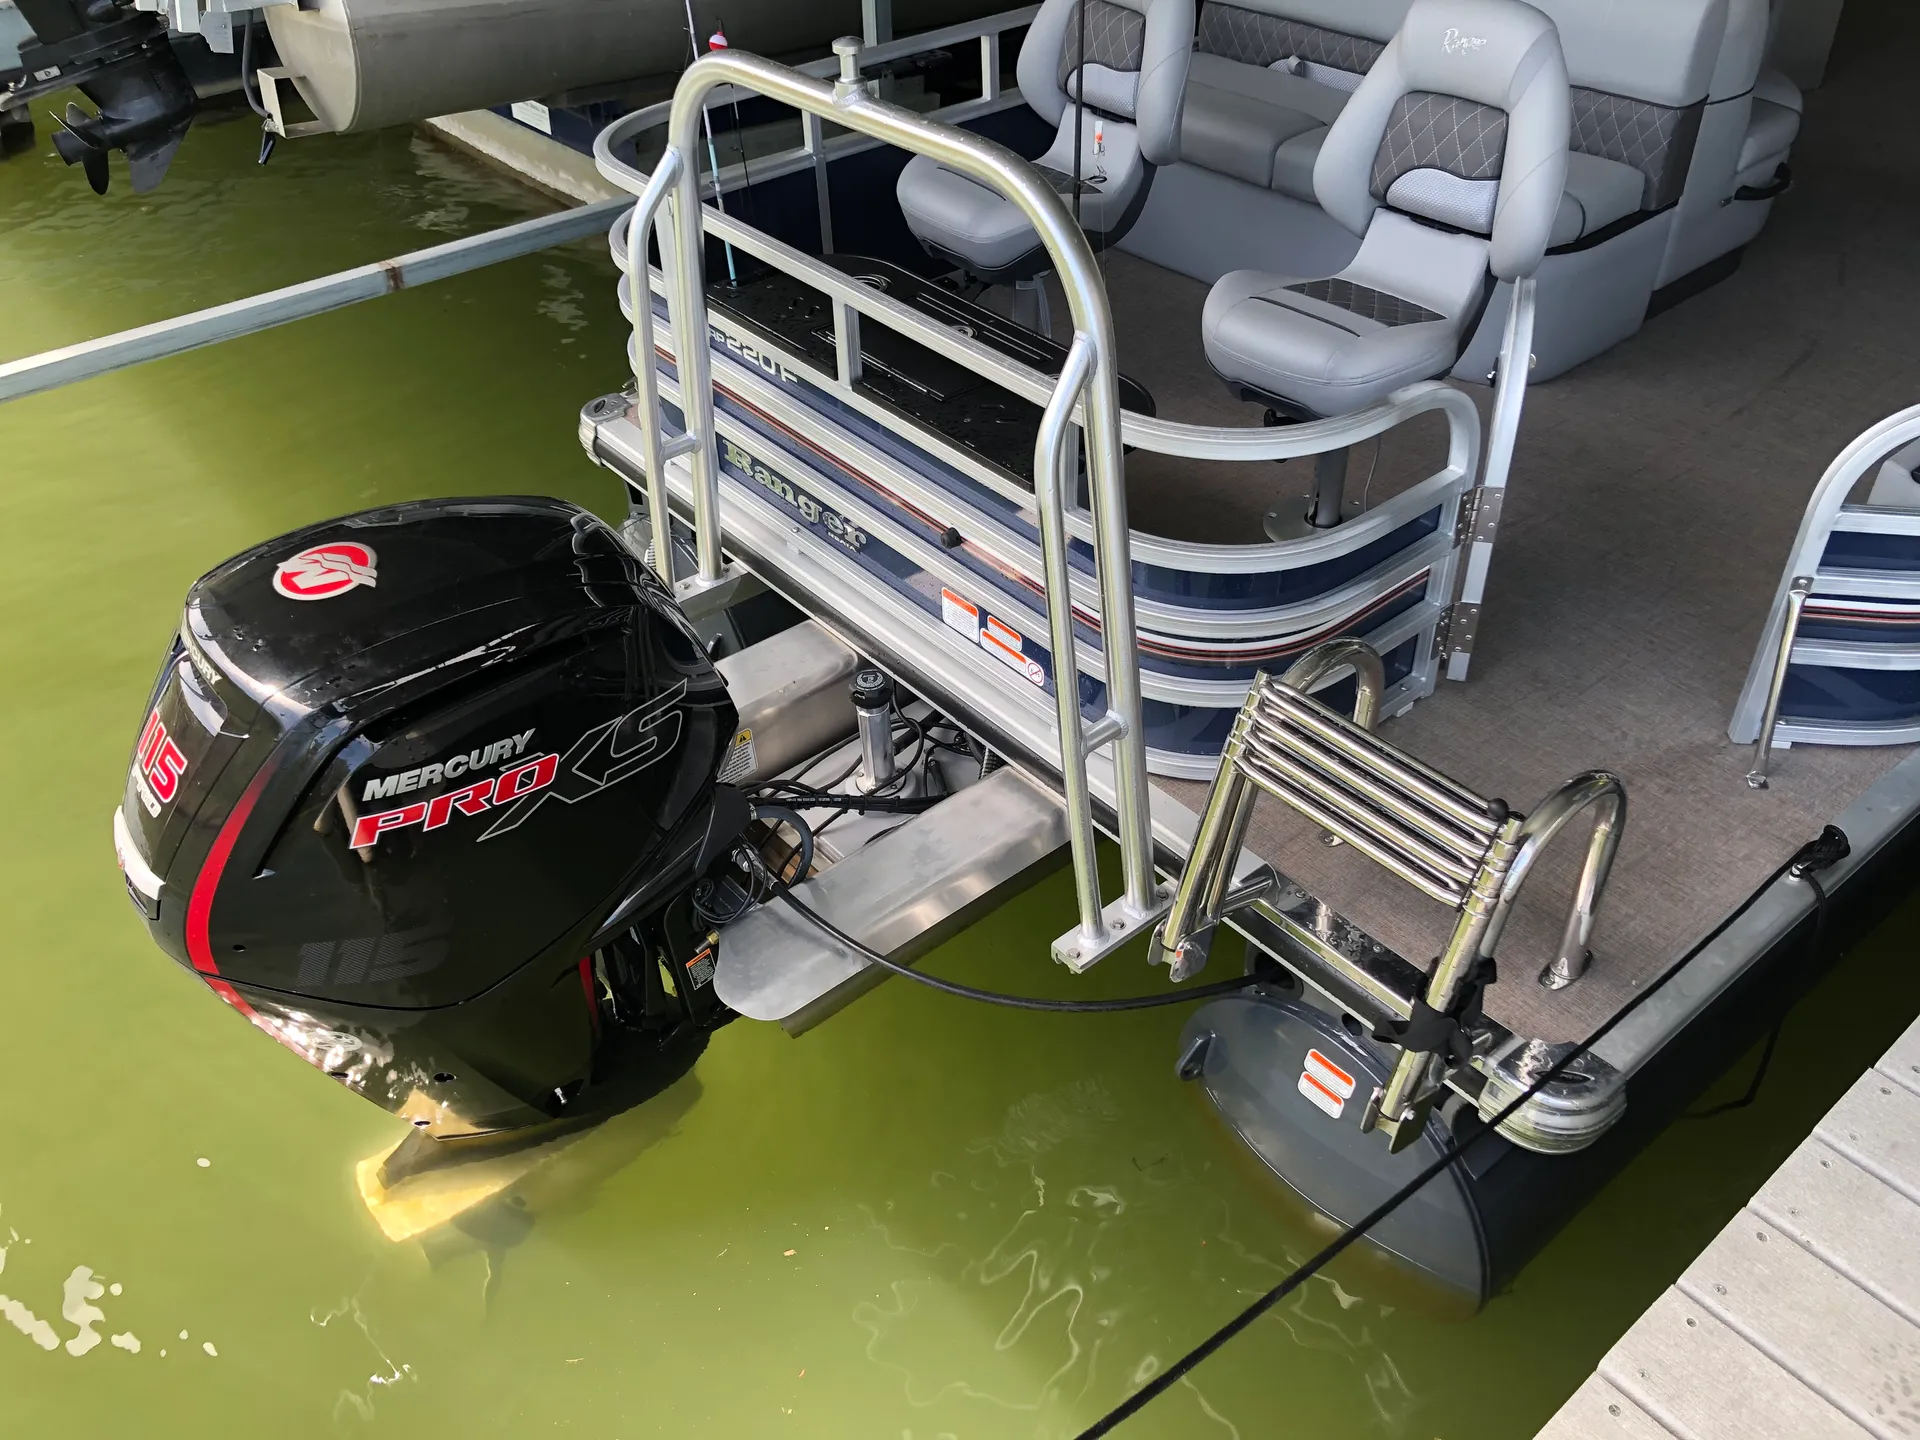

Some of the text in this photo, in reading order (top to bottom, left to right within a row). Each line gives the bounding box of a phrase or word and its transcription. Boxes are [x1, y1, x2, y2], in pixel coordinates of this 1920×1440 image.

[722, 439, 867, 549] Ranger
[137, 707, 188, 803] 115
[349, 677, 688, 849] PRO XS
[361, 727, 536, 802] MERCURY
